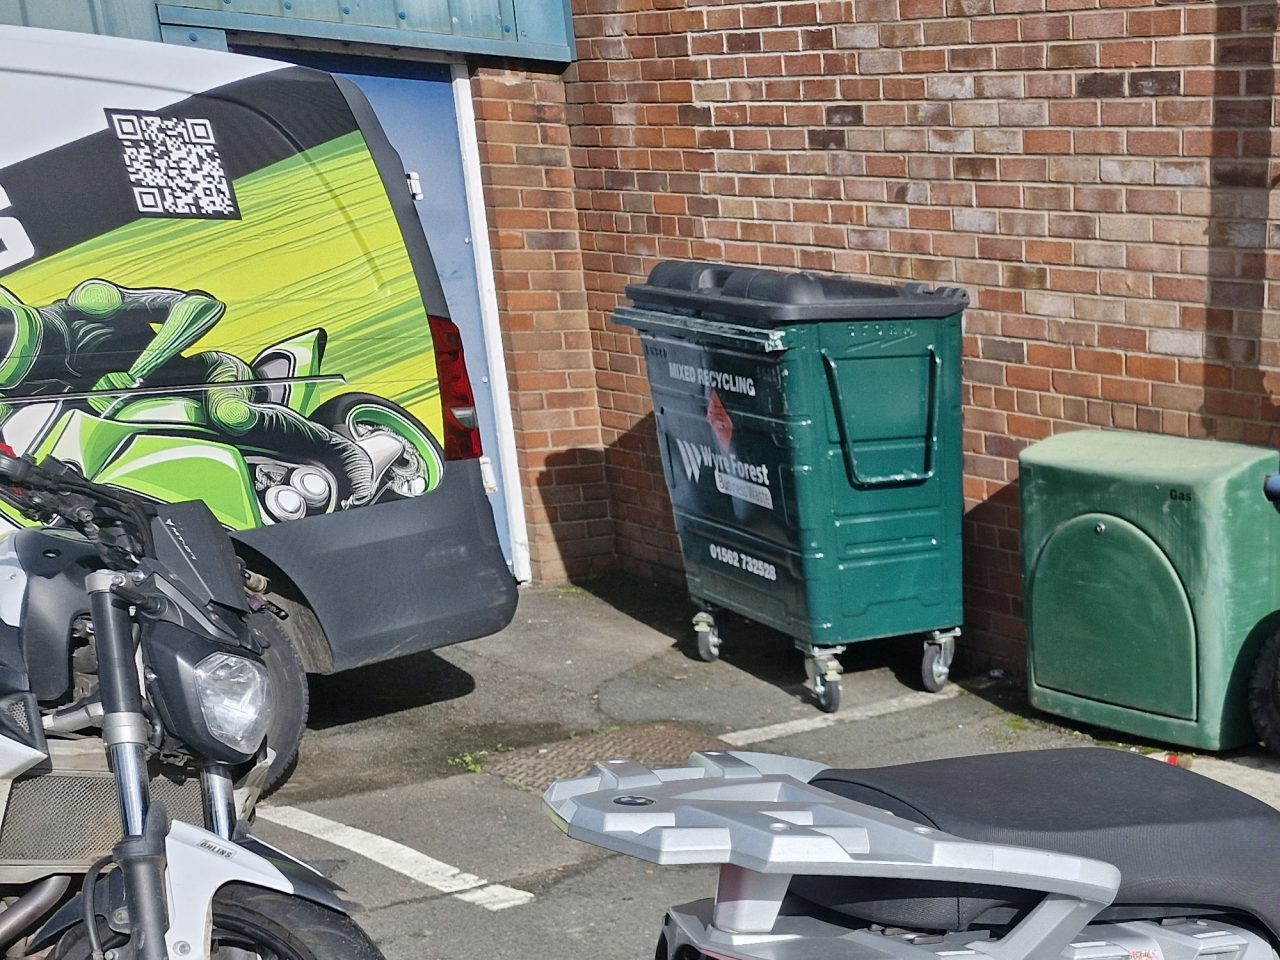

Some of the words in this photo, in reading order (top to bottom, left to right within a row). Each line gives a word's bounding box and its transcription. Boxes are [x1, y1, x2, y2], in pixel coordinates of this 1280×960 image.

[668, 362, 696, 383] MIXED
[697, 368, 756, 397] RECYCLING
[699, 444, 731, 474] Wyre
[729, 453, 770, 486] Forest
[1169, 489, 1192, 502] Gas
[709, 543, 740, 568] 01562
